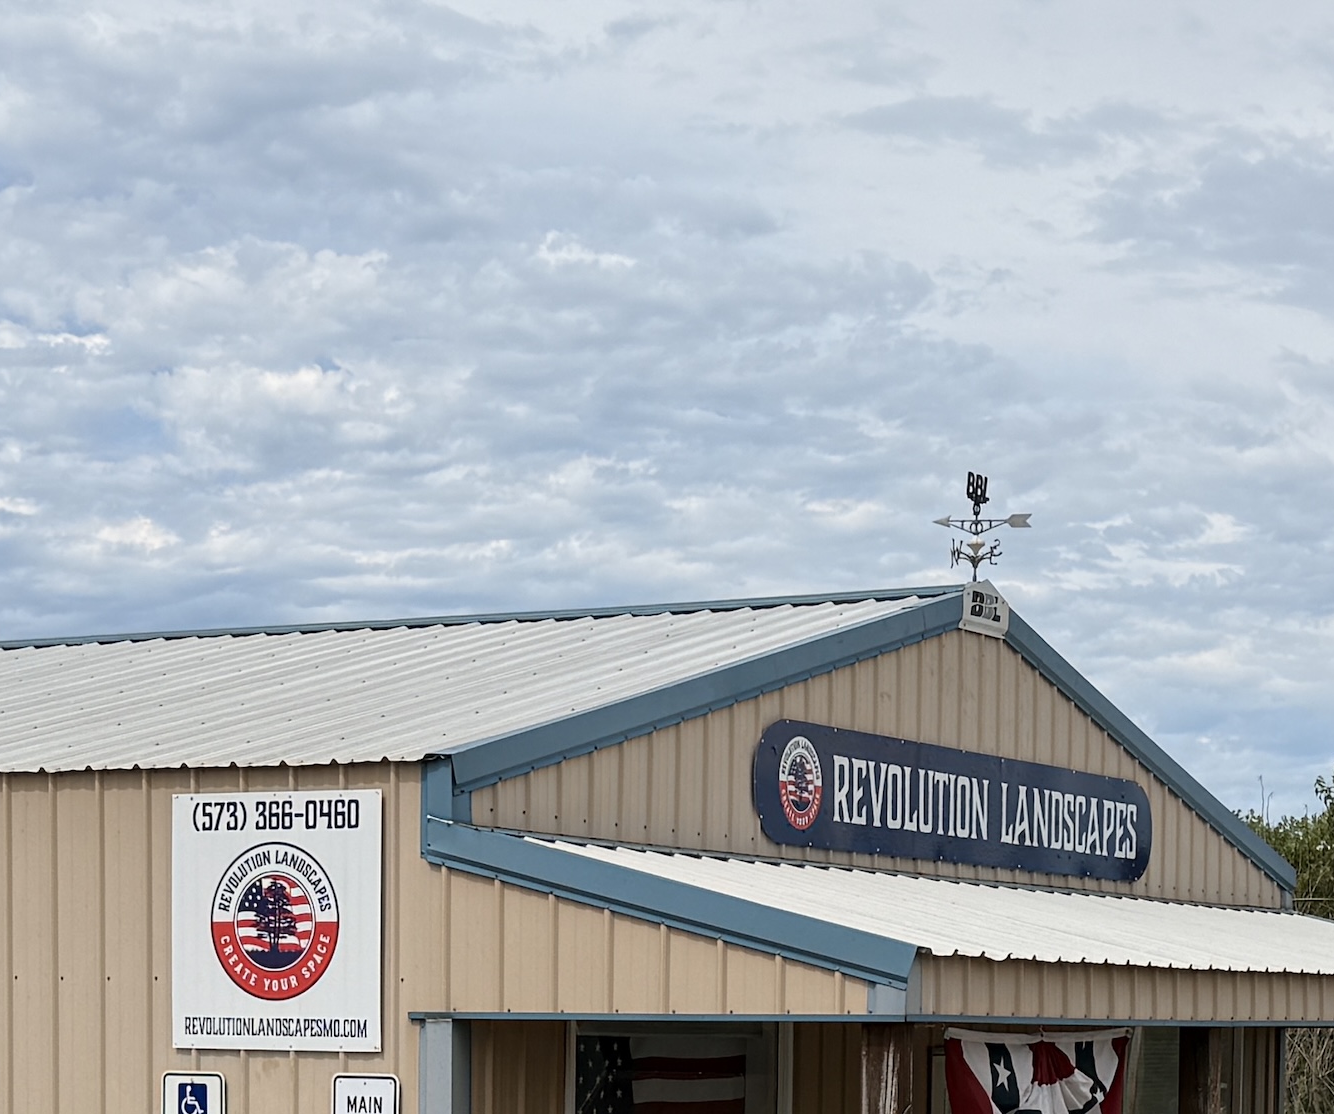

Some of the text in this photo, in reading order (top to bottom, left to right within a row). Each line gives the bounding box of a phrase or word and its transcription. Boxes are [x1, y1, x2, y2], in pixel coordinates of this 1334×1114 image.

[192, 799, 360, 832] (573) 366-0460
[833, 754, 1138, 860] REVOLUTION LANDSCAPES
[218, 849, 332, 912] REVOLUTION LANDSCAPES
[220, 933, 330, 992] CREATE YOUR SPACE
[184, 1016, 368, 1039] REVOLUTIONLANDSCAPESMO.COM
[347, 1095, 383, 1114] MAIN
